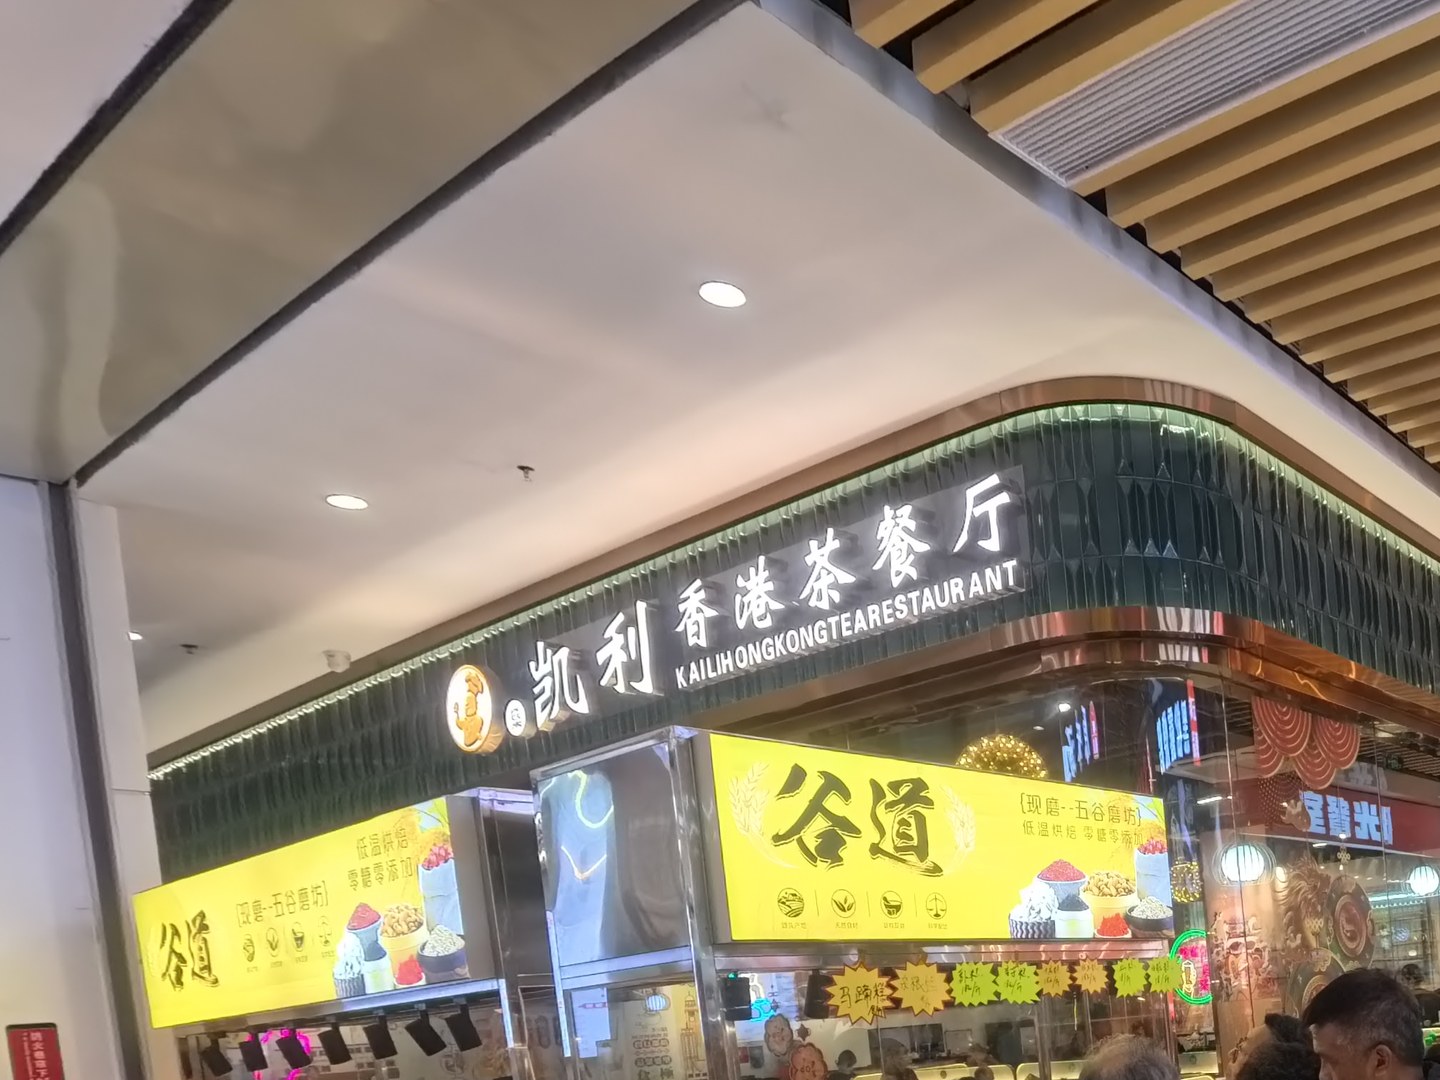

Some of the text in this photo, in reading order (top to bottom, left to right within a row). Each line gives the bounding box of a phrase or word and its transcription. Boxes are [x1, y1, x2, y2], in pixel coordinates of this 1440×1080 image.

[529, 473, 1012, 717] 凯利香港茶餐厅
[675, 560, 1018, 690] KAILIHONGKONGTEARESTAURANT
[356, 827, 409, 861] 低温烘焙
[771, 763, 943, 877] 谷道
[1023, 820, 1143, 849] 低温烘焙 零糖零添加
[347, 856, 414, 892] 零糖零添加
[160, 909, 220, 993] 谷道
